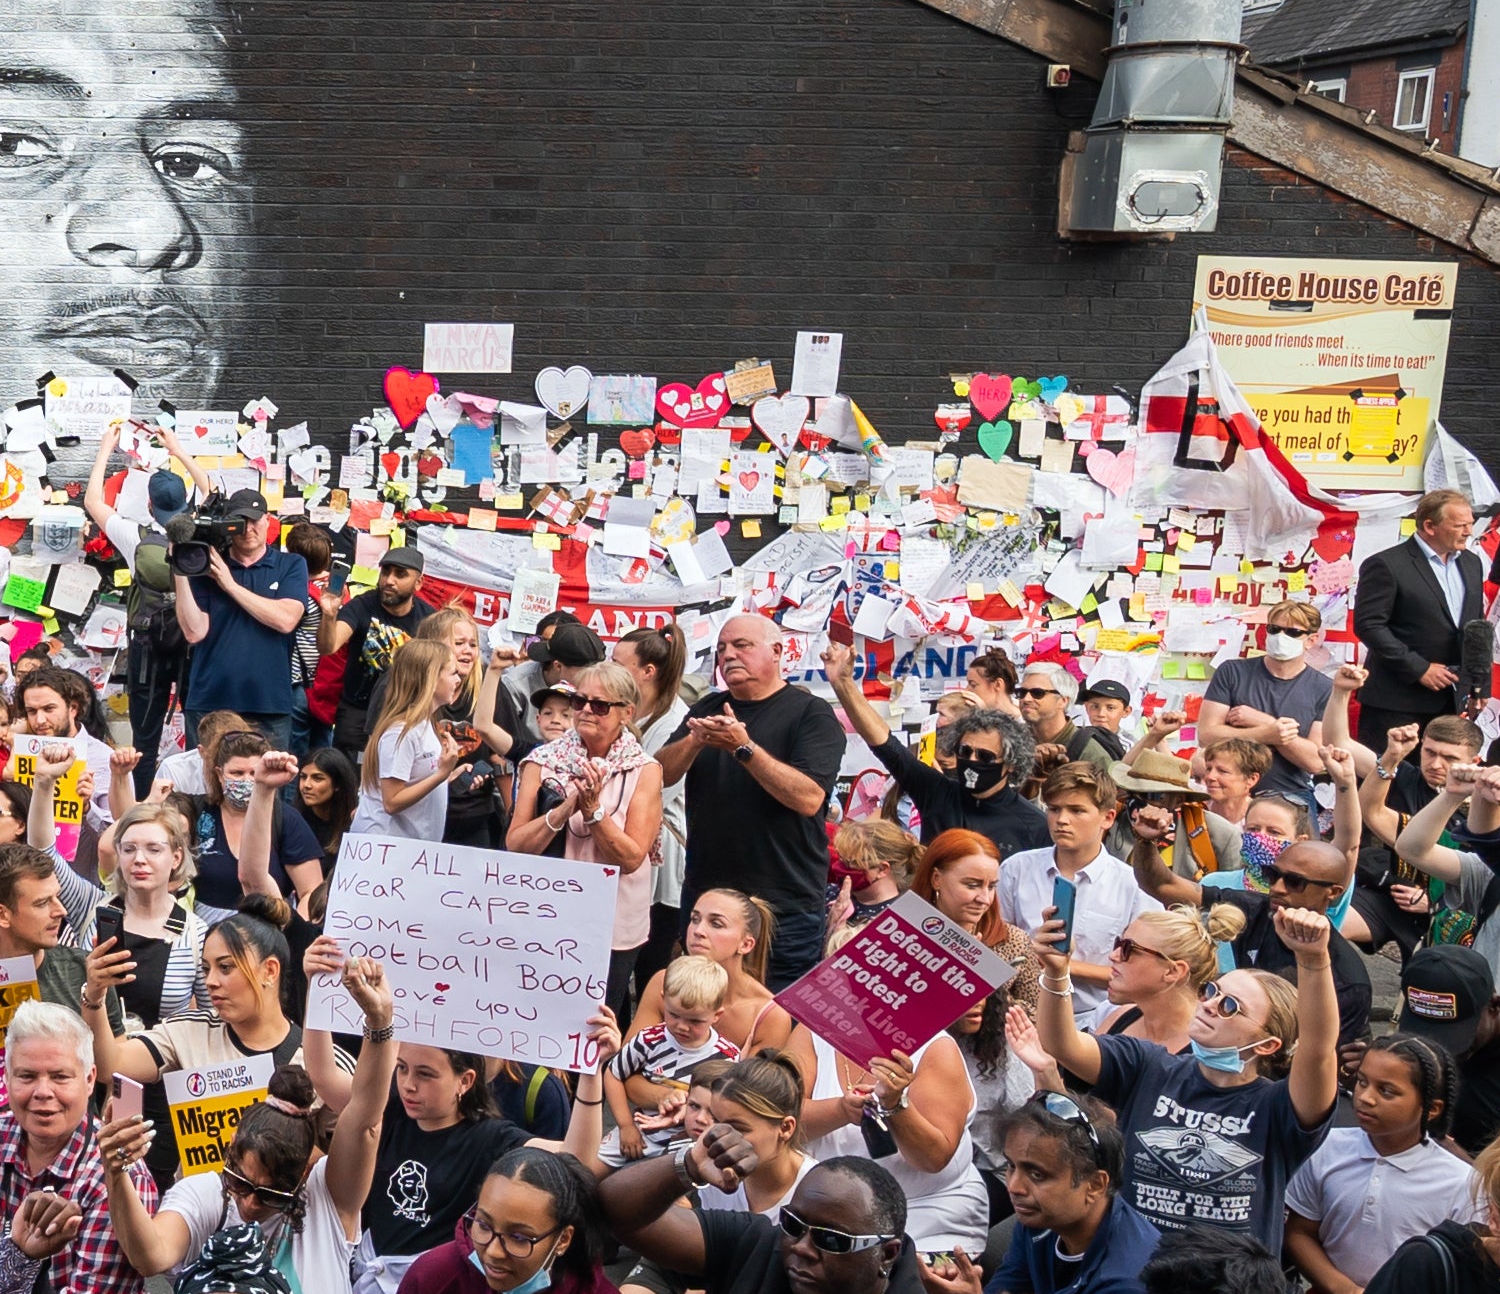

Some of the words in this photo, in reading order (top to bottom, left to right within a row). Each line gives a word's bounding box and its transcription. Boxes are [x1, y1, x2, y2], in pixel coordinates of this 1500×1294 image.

[1208, 270, 1291, 297] Coffee
[1298, 272, 1378, 300] House
[1384, 274, 1444, 303] Café
[1245, 335, 1272, 348] good
[1274, 333, 1313, 348] friends
[1316, 336, 1343, 349] meet
[427, 346, 512, 372] MARCUS
[1318, 353, 1348, 367] When
[1350, 354, 1363, 367] its
[1366, 354, 1390, 367] time
[1392, 356, 1404, 368] to
[978, 387, 1007, 401] HERO
[200, 418, 216, 426] OUR
[217, 417, 234, 426] HERO
[1274, 409, 1299, 426] you
[1305, 406, 1331, 424] had
[1285, 436, 1321, 450] meal
[1326, 434, 1341, 450] of
[344, 841, 396, 865] NOT
[411, 849, 461, 876] ALL
[331, 910, 428, 940] SOME
[876, 916, 948, 972] Defend
[941, 964, 976, 997] the
[938, 933, 951, 946] TO
[948, 940, 979, 967] RACISM
[944, 928, 975, 951] STAND
[968, 943, 982, 957] UP
[855, 937, 907, 978] right
[905, 971, 928, 993] to
[832, 955, 908, 1011] protest
[796, 984, 862, 1037] Matter
[815, 970, 871, 1016] Black
[867, 1008, 917, 1050] Lives
[321, 994, 562, 1059] RSHFORD
[568, 1032, 600, 1069] 10
[1153, 1095, 1255, 1136] STUSSY
[1134, 1158, 1159, 1169] TRADE
[1135, 1165, 1157, 1176] MARK
[1137, 1196, 1186, 1215] LONG
[1186, 1193, 1214, 1206] FOR
[1220, 1196, 1250, 1207] THE
